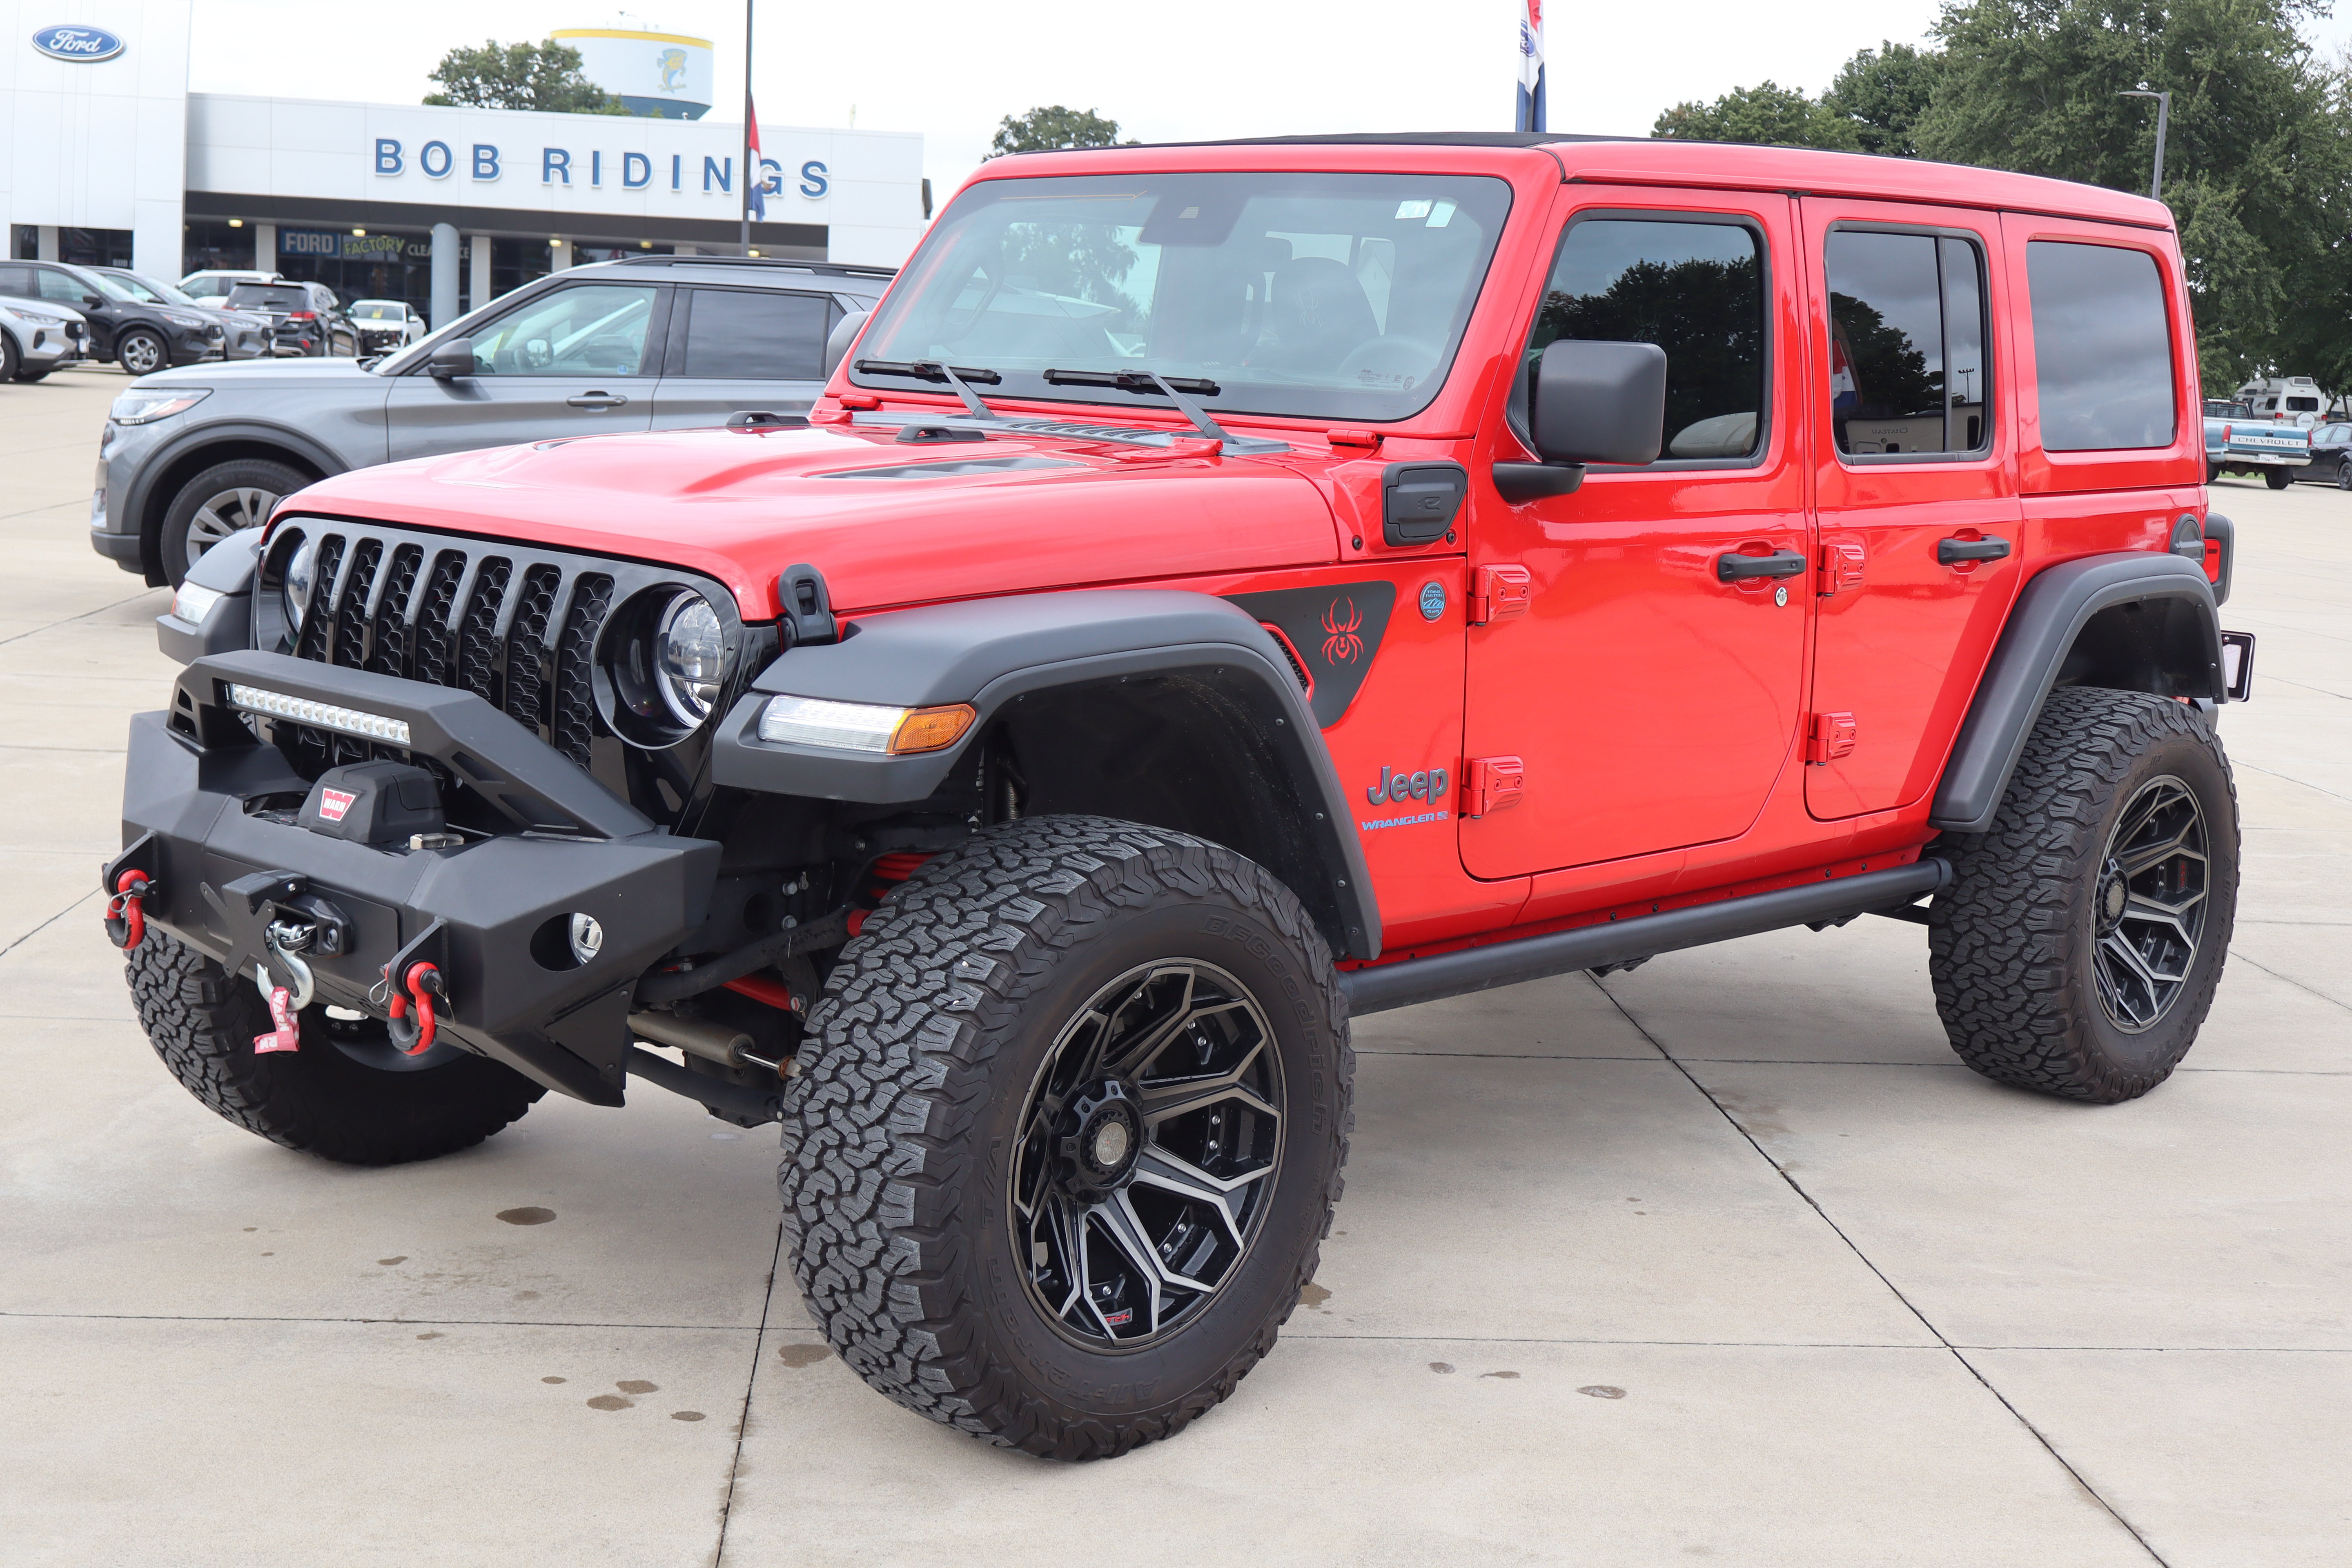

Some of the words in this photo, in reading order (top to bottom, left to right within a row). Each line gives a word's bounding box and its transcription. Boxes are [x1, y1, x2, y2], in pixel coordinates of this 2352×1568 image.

[49, 29, 102, 52] Ford
[376, 138, 502, 182] BOB
[543, 147, 830, 200] RIDINGS
[286, 233, 333, 254] FORD
[344, 237, 405, 256] FACTORY
[2238, 437, 2300, 445] CHEVROLET
[1368, 766, 1448, 805] Jeep
[323, 797, 346, 813] WARN
[1361, 813, 1435, 831] WRANGLER
[272, 990, 290, 1031] WARN
[1199, 915, 1327, 1136] BFGoodrich
